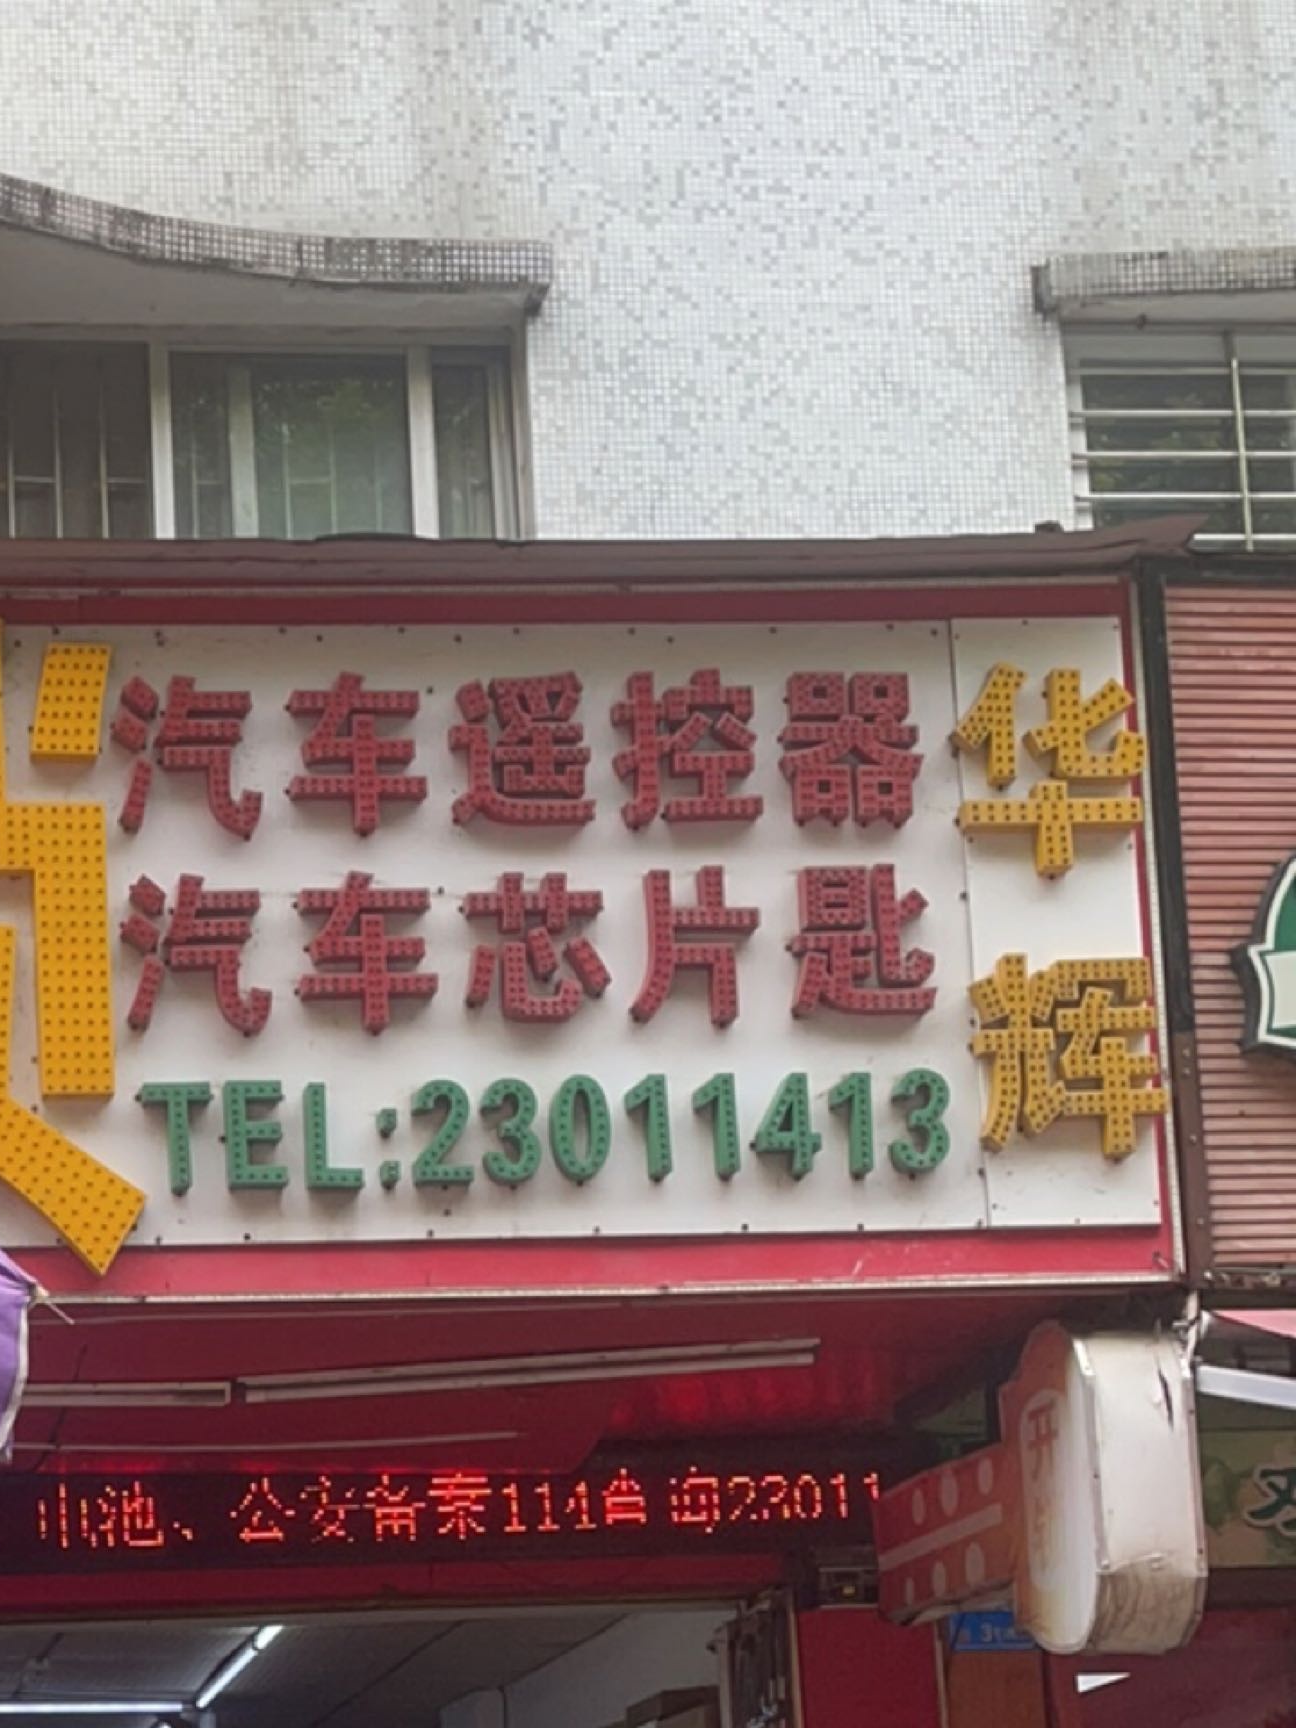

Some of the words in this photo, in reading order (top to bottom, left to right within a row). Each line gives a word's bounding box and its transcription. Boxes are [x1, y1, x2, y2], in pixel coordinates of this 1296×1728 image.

[111, 668, 923, 841] 汽车遥控器
[120, 863, 939, 1037] 汽车芯片匙
[953, 662, 1167, 1162] 华辉
[136, 1067, 951, 1198] TEL:23011413
